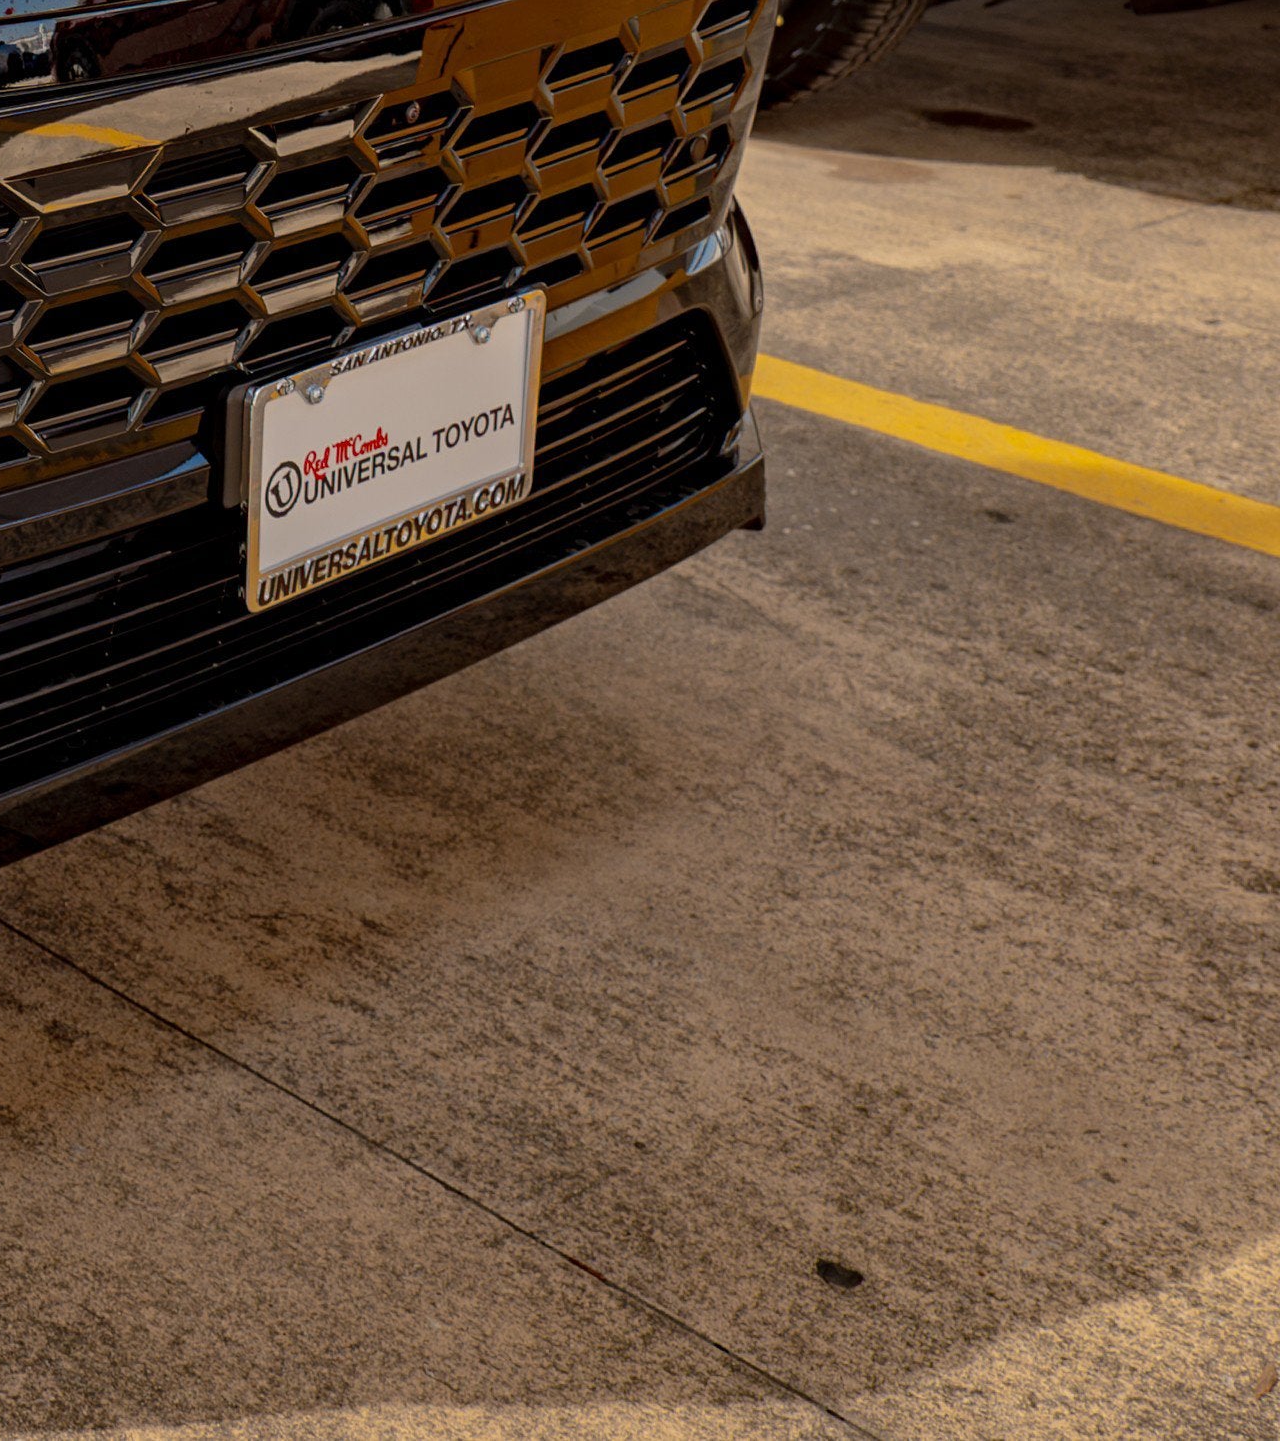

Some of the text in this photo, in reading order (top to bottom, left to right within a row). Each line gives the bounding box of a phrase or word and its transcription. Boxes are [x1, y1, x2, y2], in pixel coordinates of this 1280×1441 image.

[329, 351, 365, 377] SAN
[303, 447, 330, 481] Red
[304, 403, 515, 504] UNIVERSAL TOYOTA
[257, 473, 527, 607] UNIVERSALTOYOTA.COM
